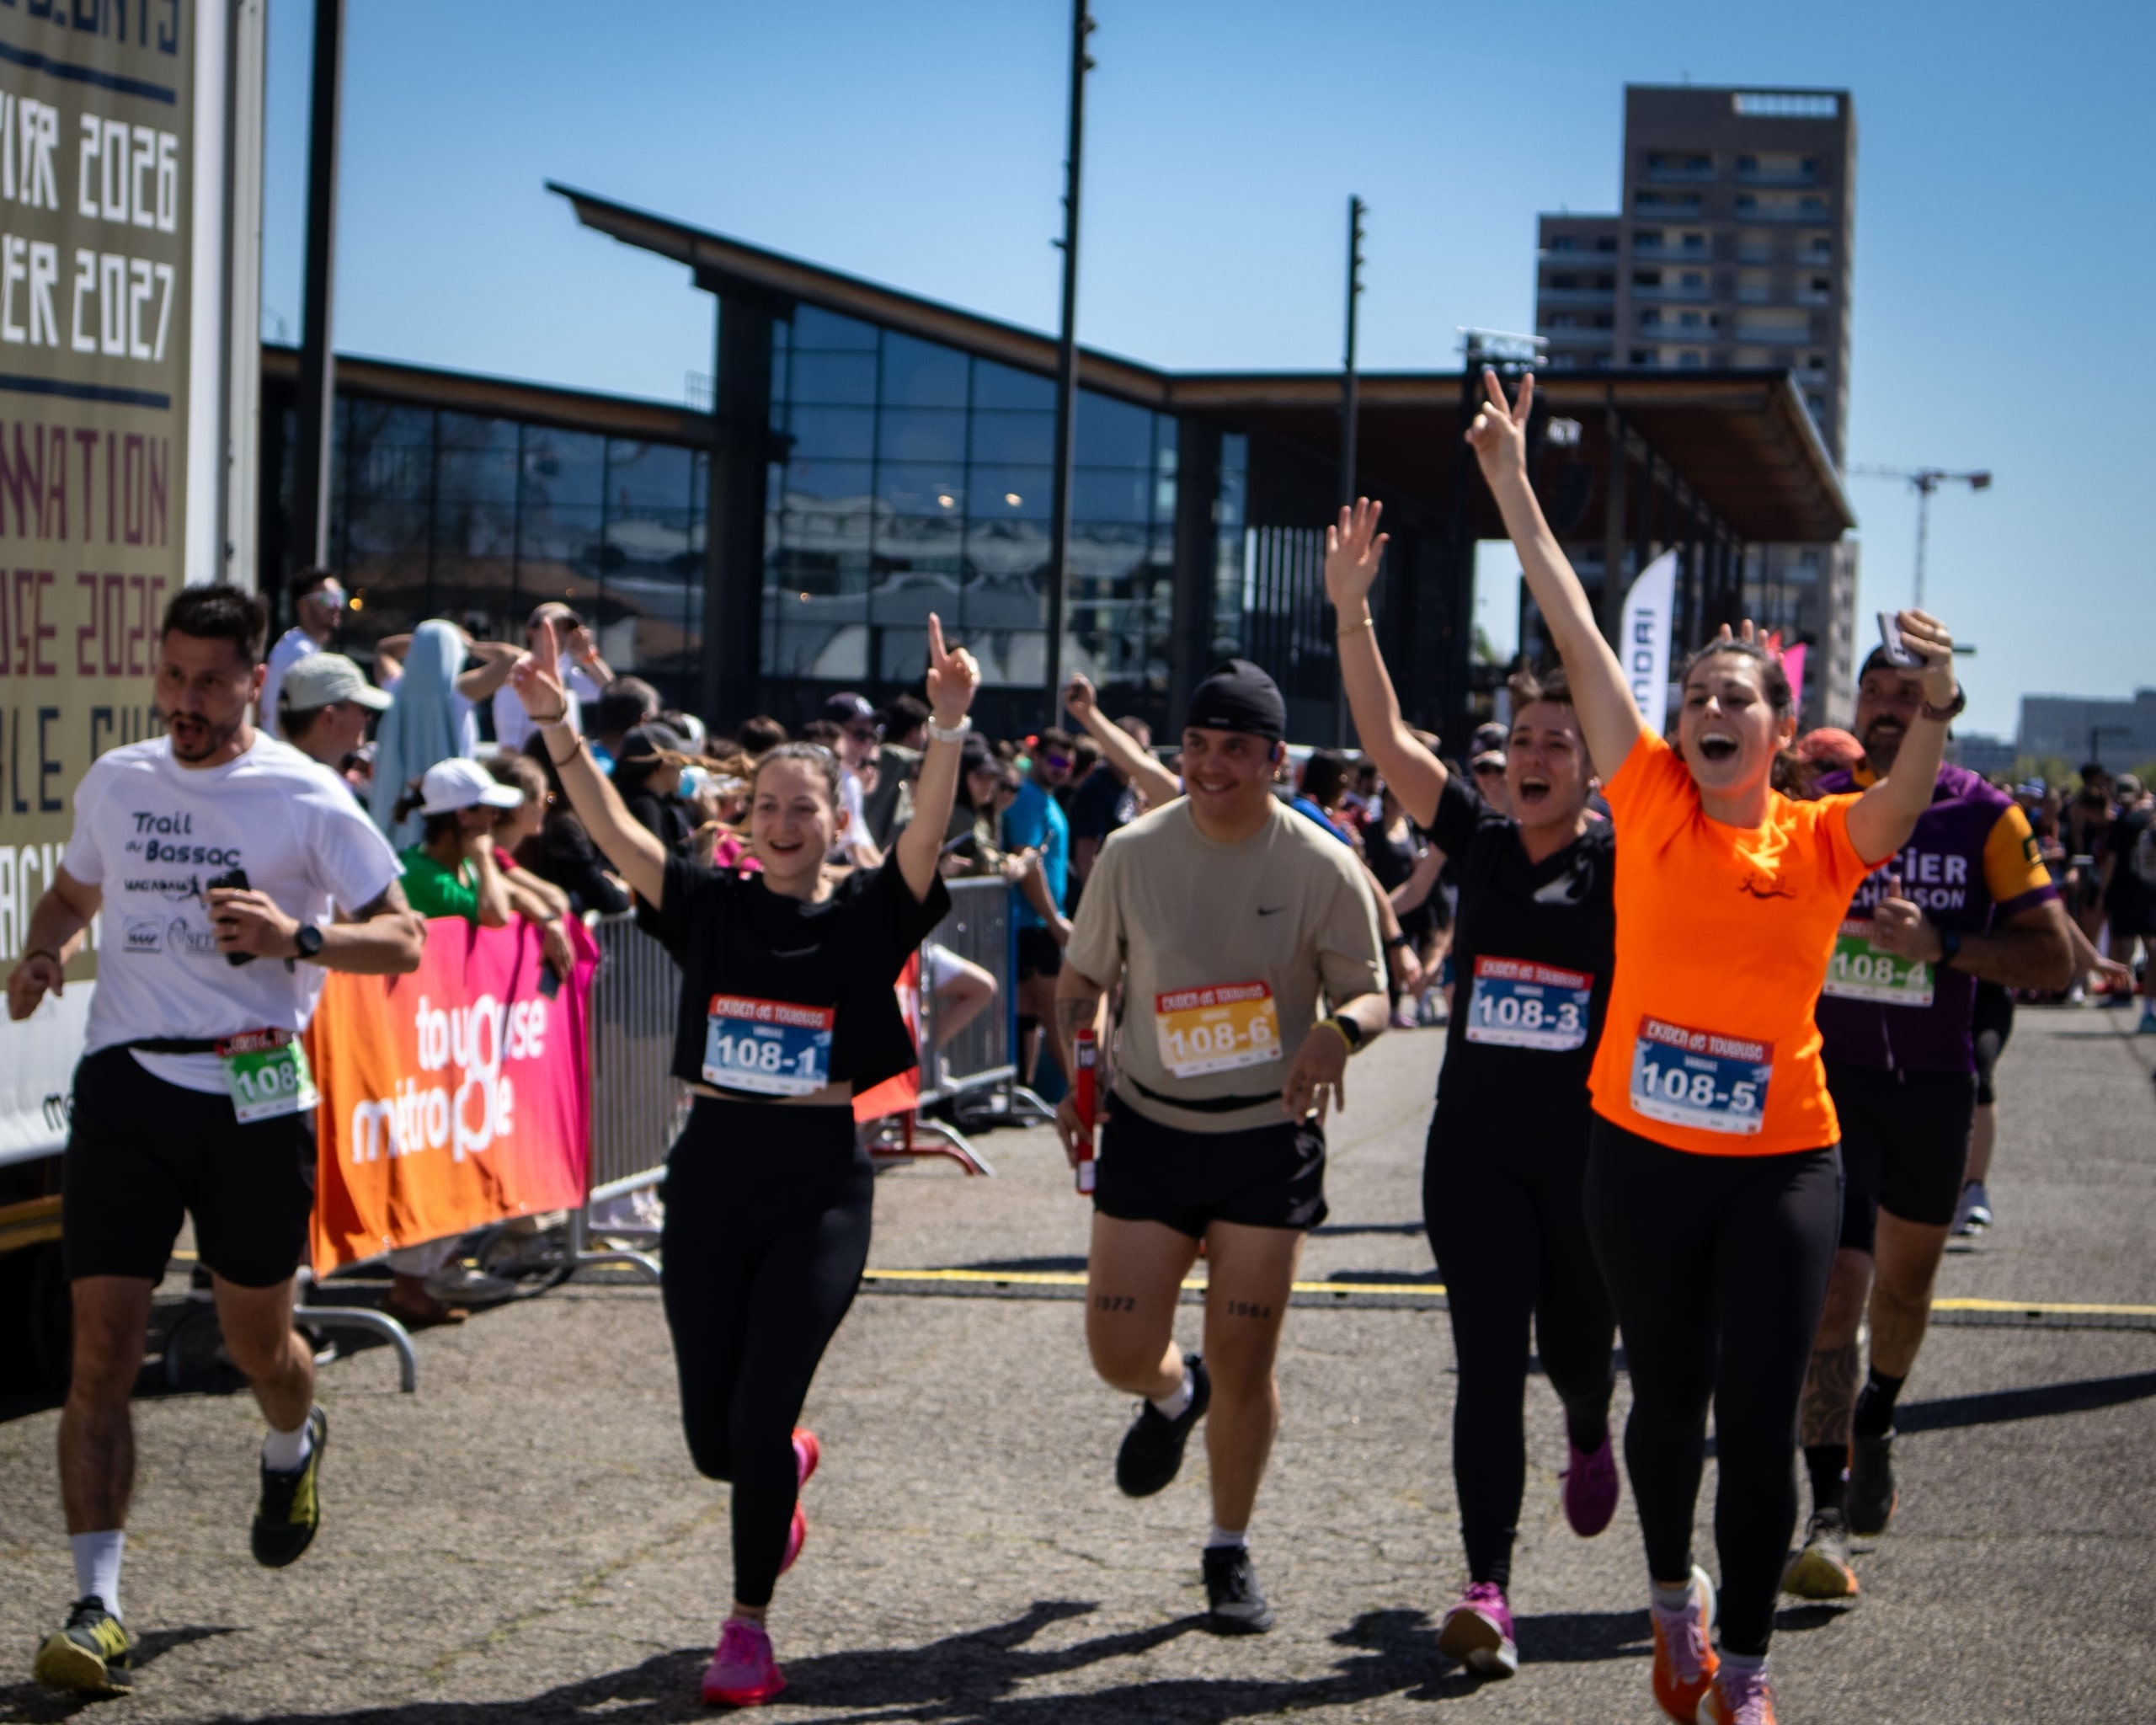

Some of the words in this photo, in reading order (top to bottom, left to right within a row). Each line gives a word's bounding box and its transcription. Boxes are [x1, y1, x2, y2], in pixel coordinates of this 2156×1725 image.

[78, 112, 178, 234] 2026
[72, 248, 174, 362] 2027
[132, 811, 192, 836] Trail
[146, 840, 241, 868] Bassac
[1835, 951, 1928, 985] 108-4
[1479, 995, 1581, 1033] 108-3
[717, 1034, 817, 1074] 108-1
[1170, 1017, 1270, 1056] 108-6
[237, 1061, 296, 1100] 108
[1641, 1061, 1757, 1114] 108-5
